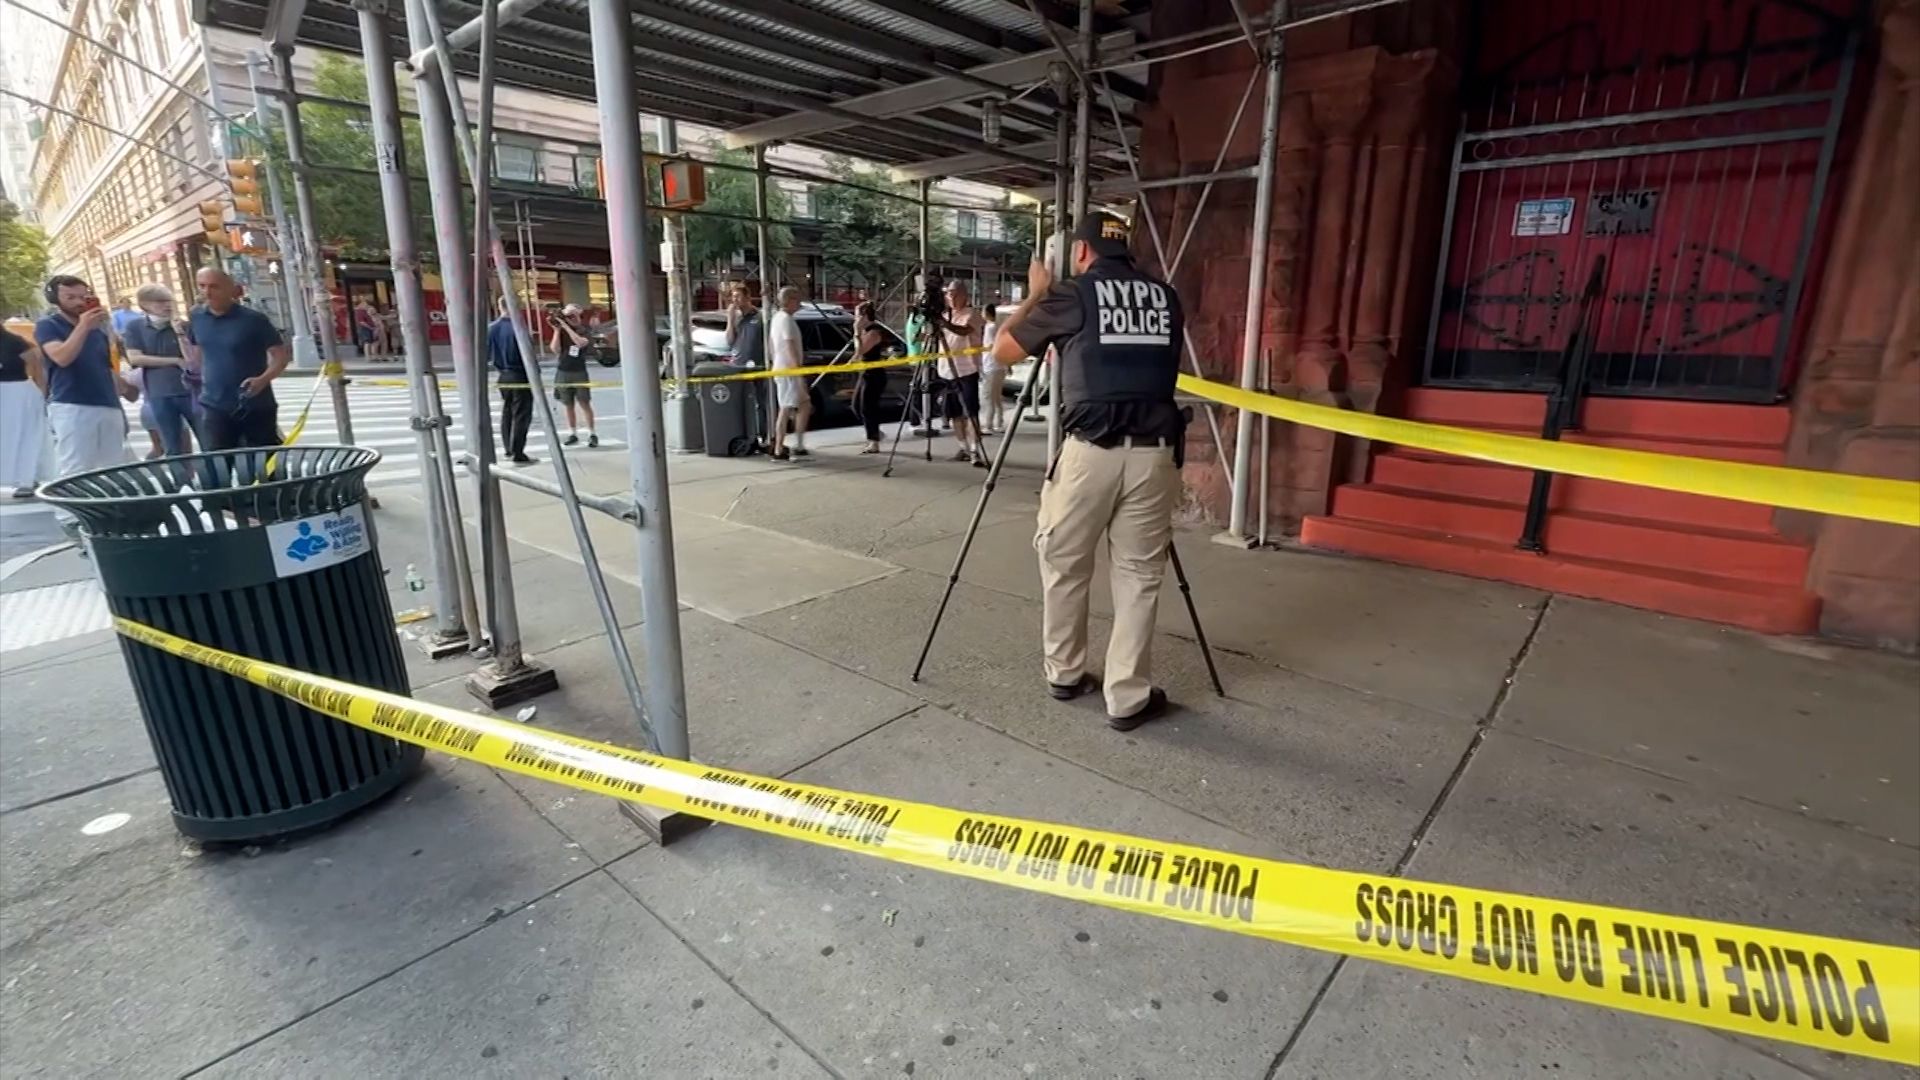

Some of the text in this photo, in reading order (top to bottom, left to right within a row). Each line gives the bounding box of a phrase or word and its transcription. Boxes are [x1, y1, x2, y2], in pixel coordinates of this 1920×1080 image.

[1094, 279, 1168, 309] NYPD
[1099, 308, 1171, 335] POLICE
[948, 818, 1259, 923] POLICE LINE DO NOT CROSS
[1356, 883, 1890, 1044] POLICE LINE DO NOT CROSS
